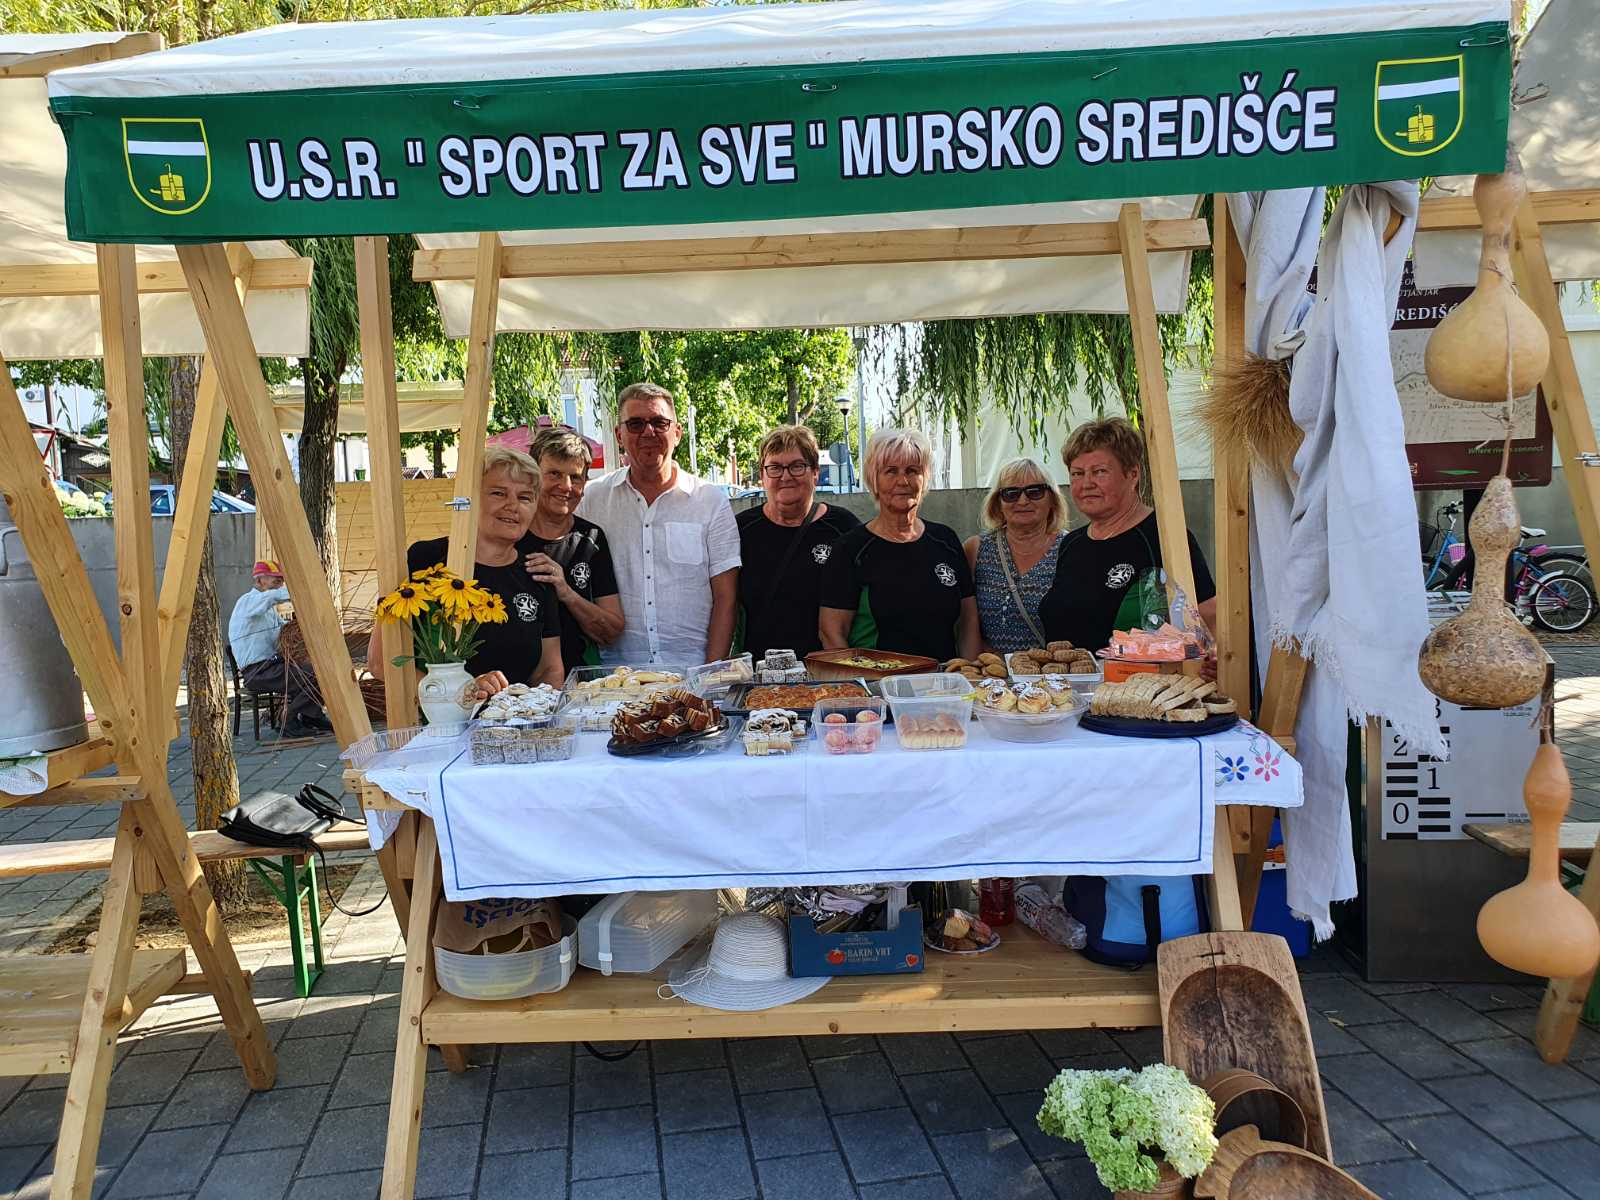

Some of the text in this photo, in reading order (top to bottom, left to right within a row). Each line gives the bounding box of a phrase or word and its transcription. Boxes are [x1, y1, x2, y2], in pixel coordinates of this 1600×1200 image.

[248, 139, 396, 200] U.S.R.
[439, 133, 606, 197] SPORT
[618, 130, 689, 191] ZA
[700, 123, 796, 187] SVE
[840, 104, 1062, 178] MURSKO
[1077, 72, 1336, 165] SREDIŠĆE
[1393, 734, 1408, 756] 2
[1427, 767, 1441, 790] 1
[1392, 802, 1410, 825] 0
